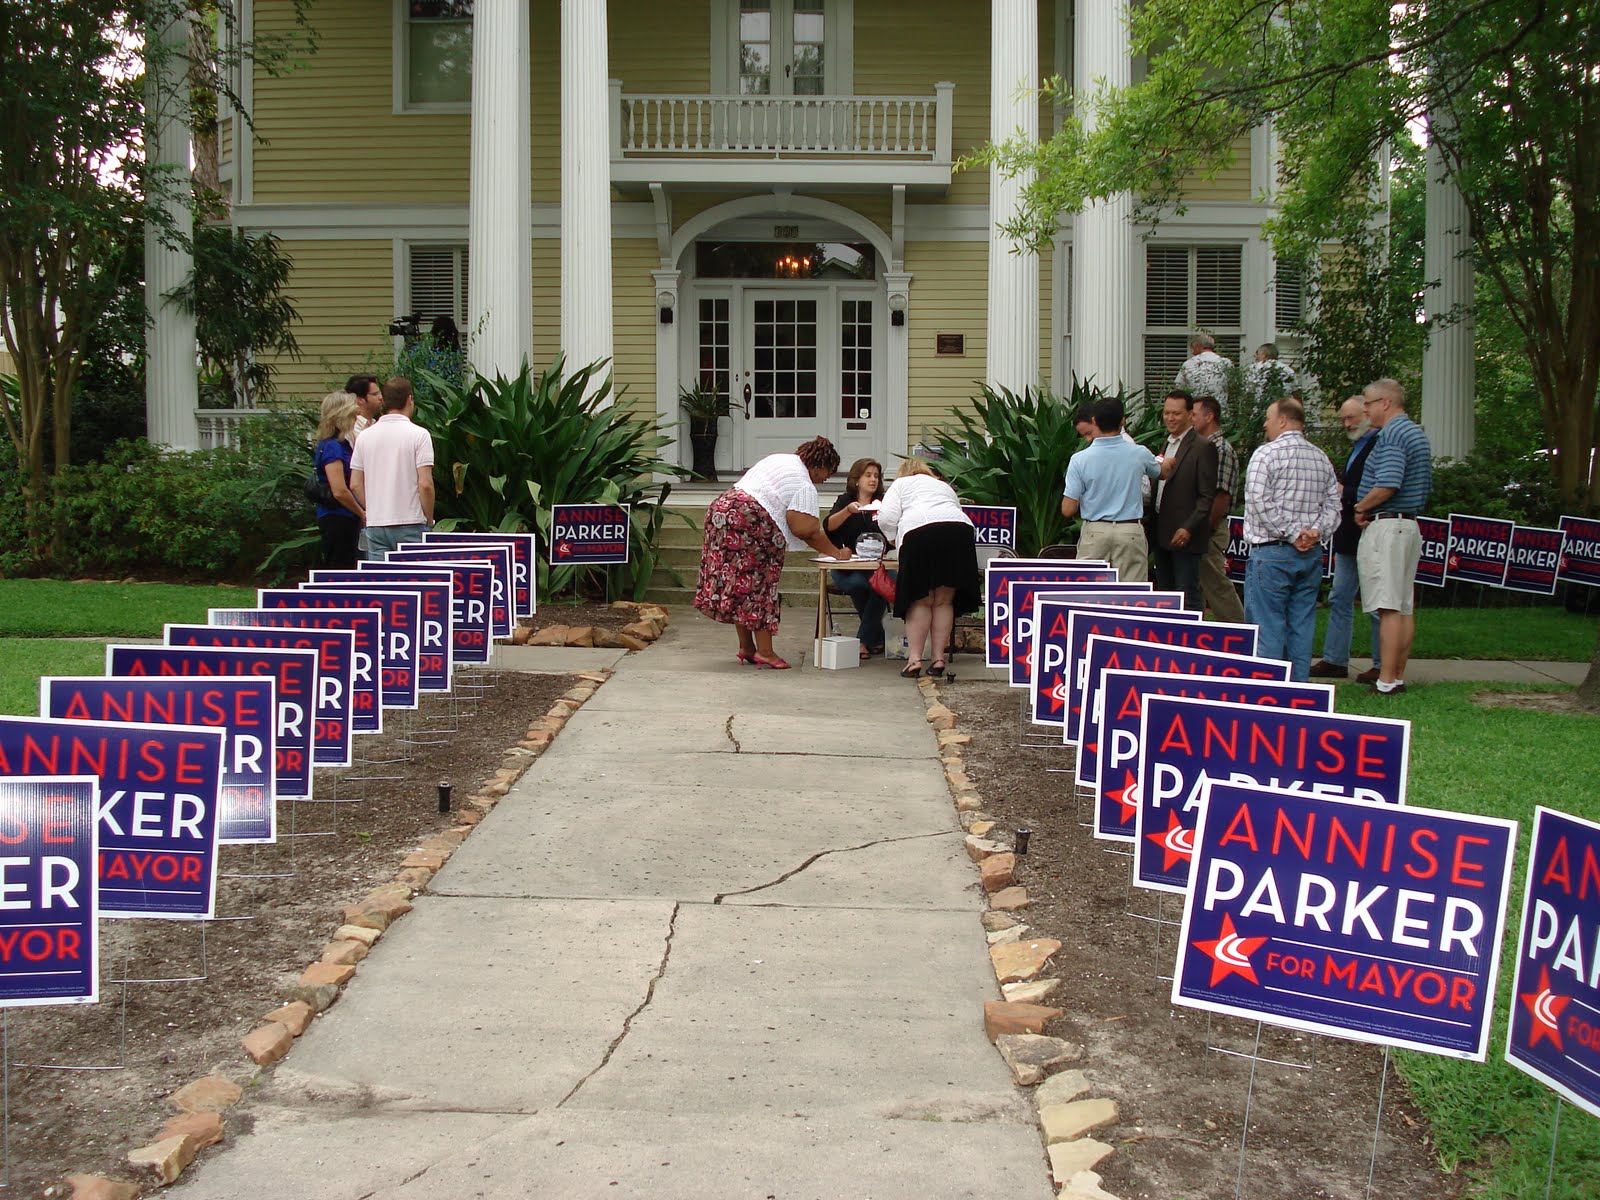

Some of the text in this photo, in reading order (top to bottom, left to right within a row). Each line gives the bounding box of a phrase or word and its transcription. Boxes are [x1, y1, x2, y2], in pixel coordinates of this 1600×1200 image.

[555, 524, 625, 540] PARKER
[558, 509, 624, 523] ANNISE
[965, 511, 1010, 527] NISE
[975, 527, 1011, 544] KER
[1448, 536, 1507, 560] PARKER
[1508, 547, 1557, 568] ARKER
[64, 690, 260, 727] ANNISE
[1159, 713, 1388, 779] ANNISE
[98, 790, 206, 839] KER
[1218, 802, 1491, 888] ANNISE
[1202, 857, 1485, 957] PARKER
[0, 929, 81, 961] YOR
[1266, 952, 1475, 1011] FOR MAYOR
